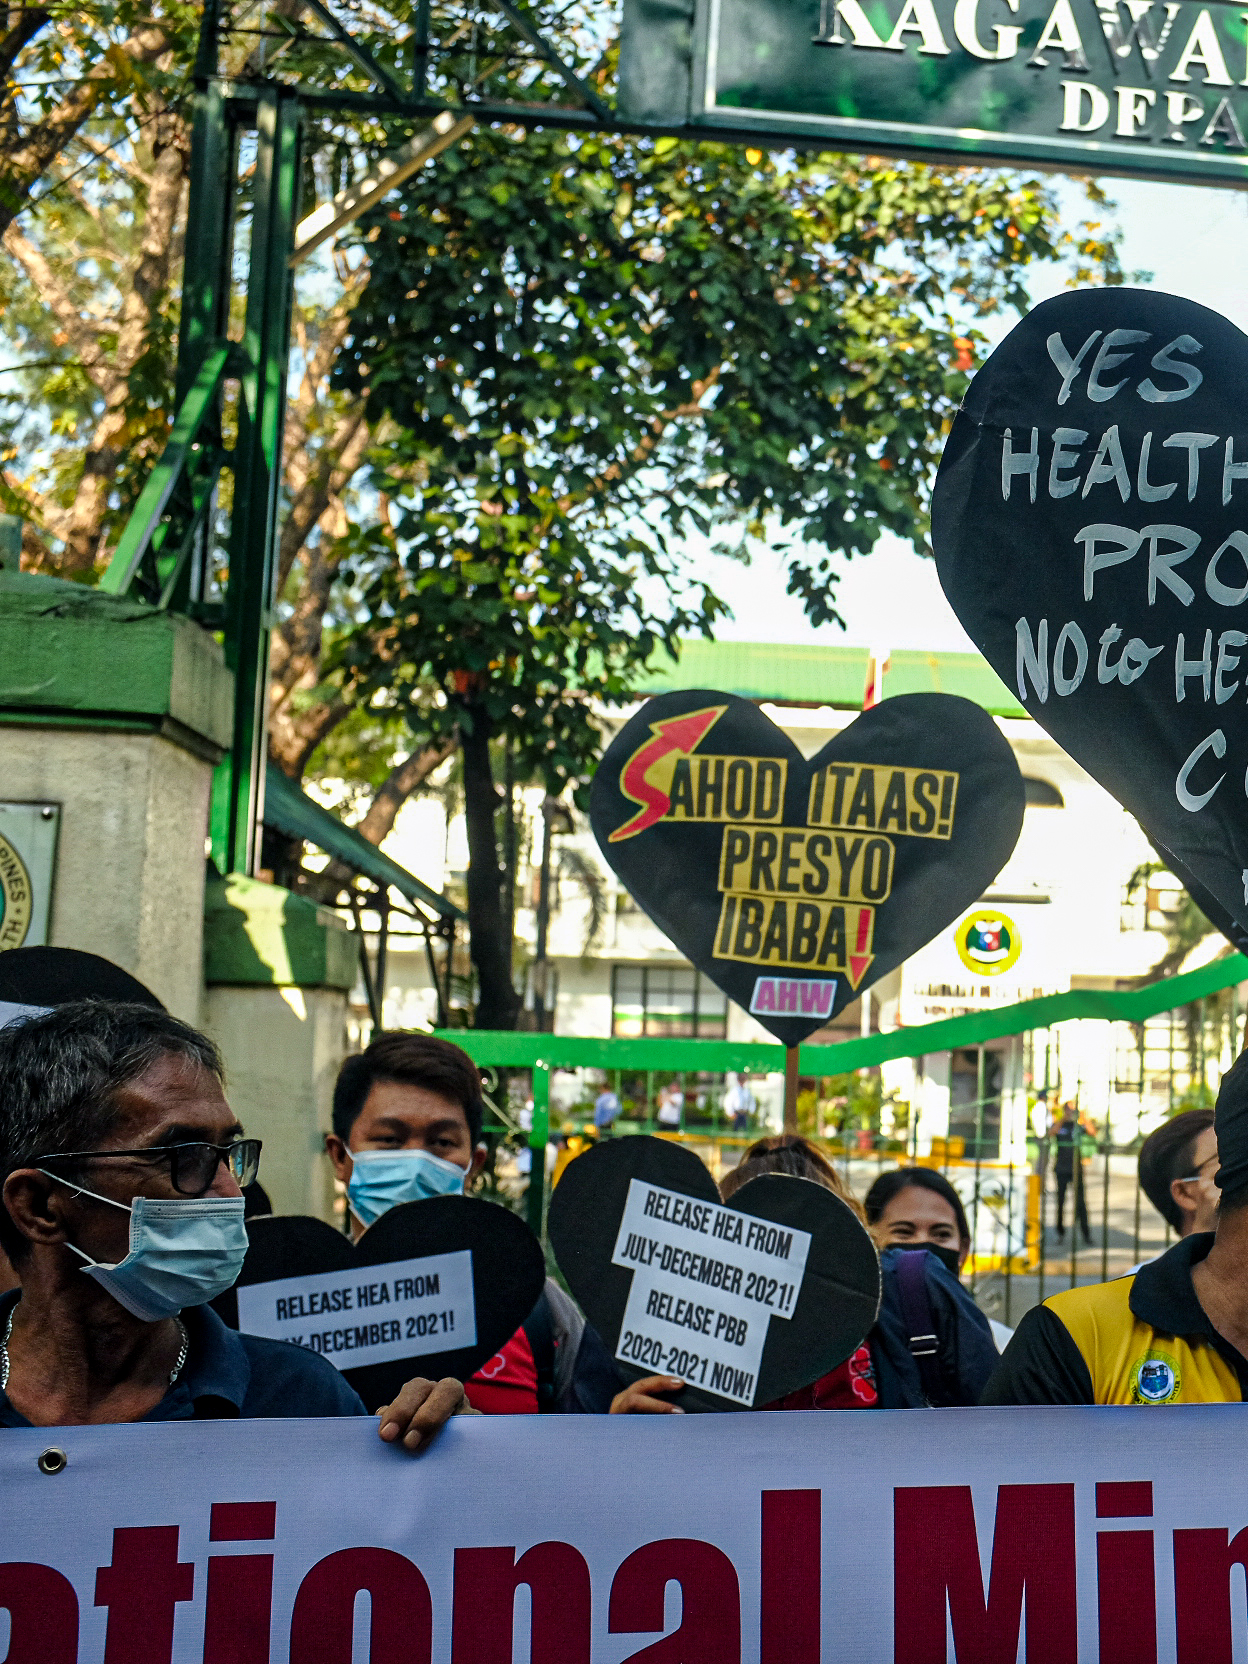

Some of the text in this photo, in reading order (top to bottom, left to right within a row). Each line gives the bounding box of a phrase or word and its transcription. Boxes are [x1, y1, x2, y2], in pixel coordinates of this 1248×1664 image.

[1046, 328, 1204, 405] YES
[1015, 616, 1088, 703] NO
[1098, 622, 1164, 685] to
[810, 765, 957, 836] ITAAS!
[723, 830, 892, 901] PRESYO
[753, 978, 835, 1016] AHW
[644, 1190, 793, 1260] RELEASE HEA FROM
[275, 1273, 441, 1322] RELEASE HEA FROM
[621, 1233, 795, 1312] JULY-DECEMBER 2021!
[405, 1310, 455, 1339] 2021!
[645, 1289, 749, 1347] RELEASE PBB
[621, 1331, 754, 1401] 2020-2021 NOW!
